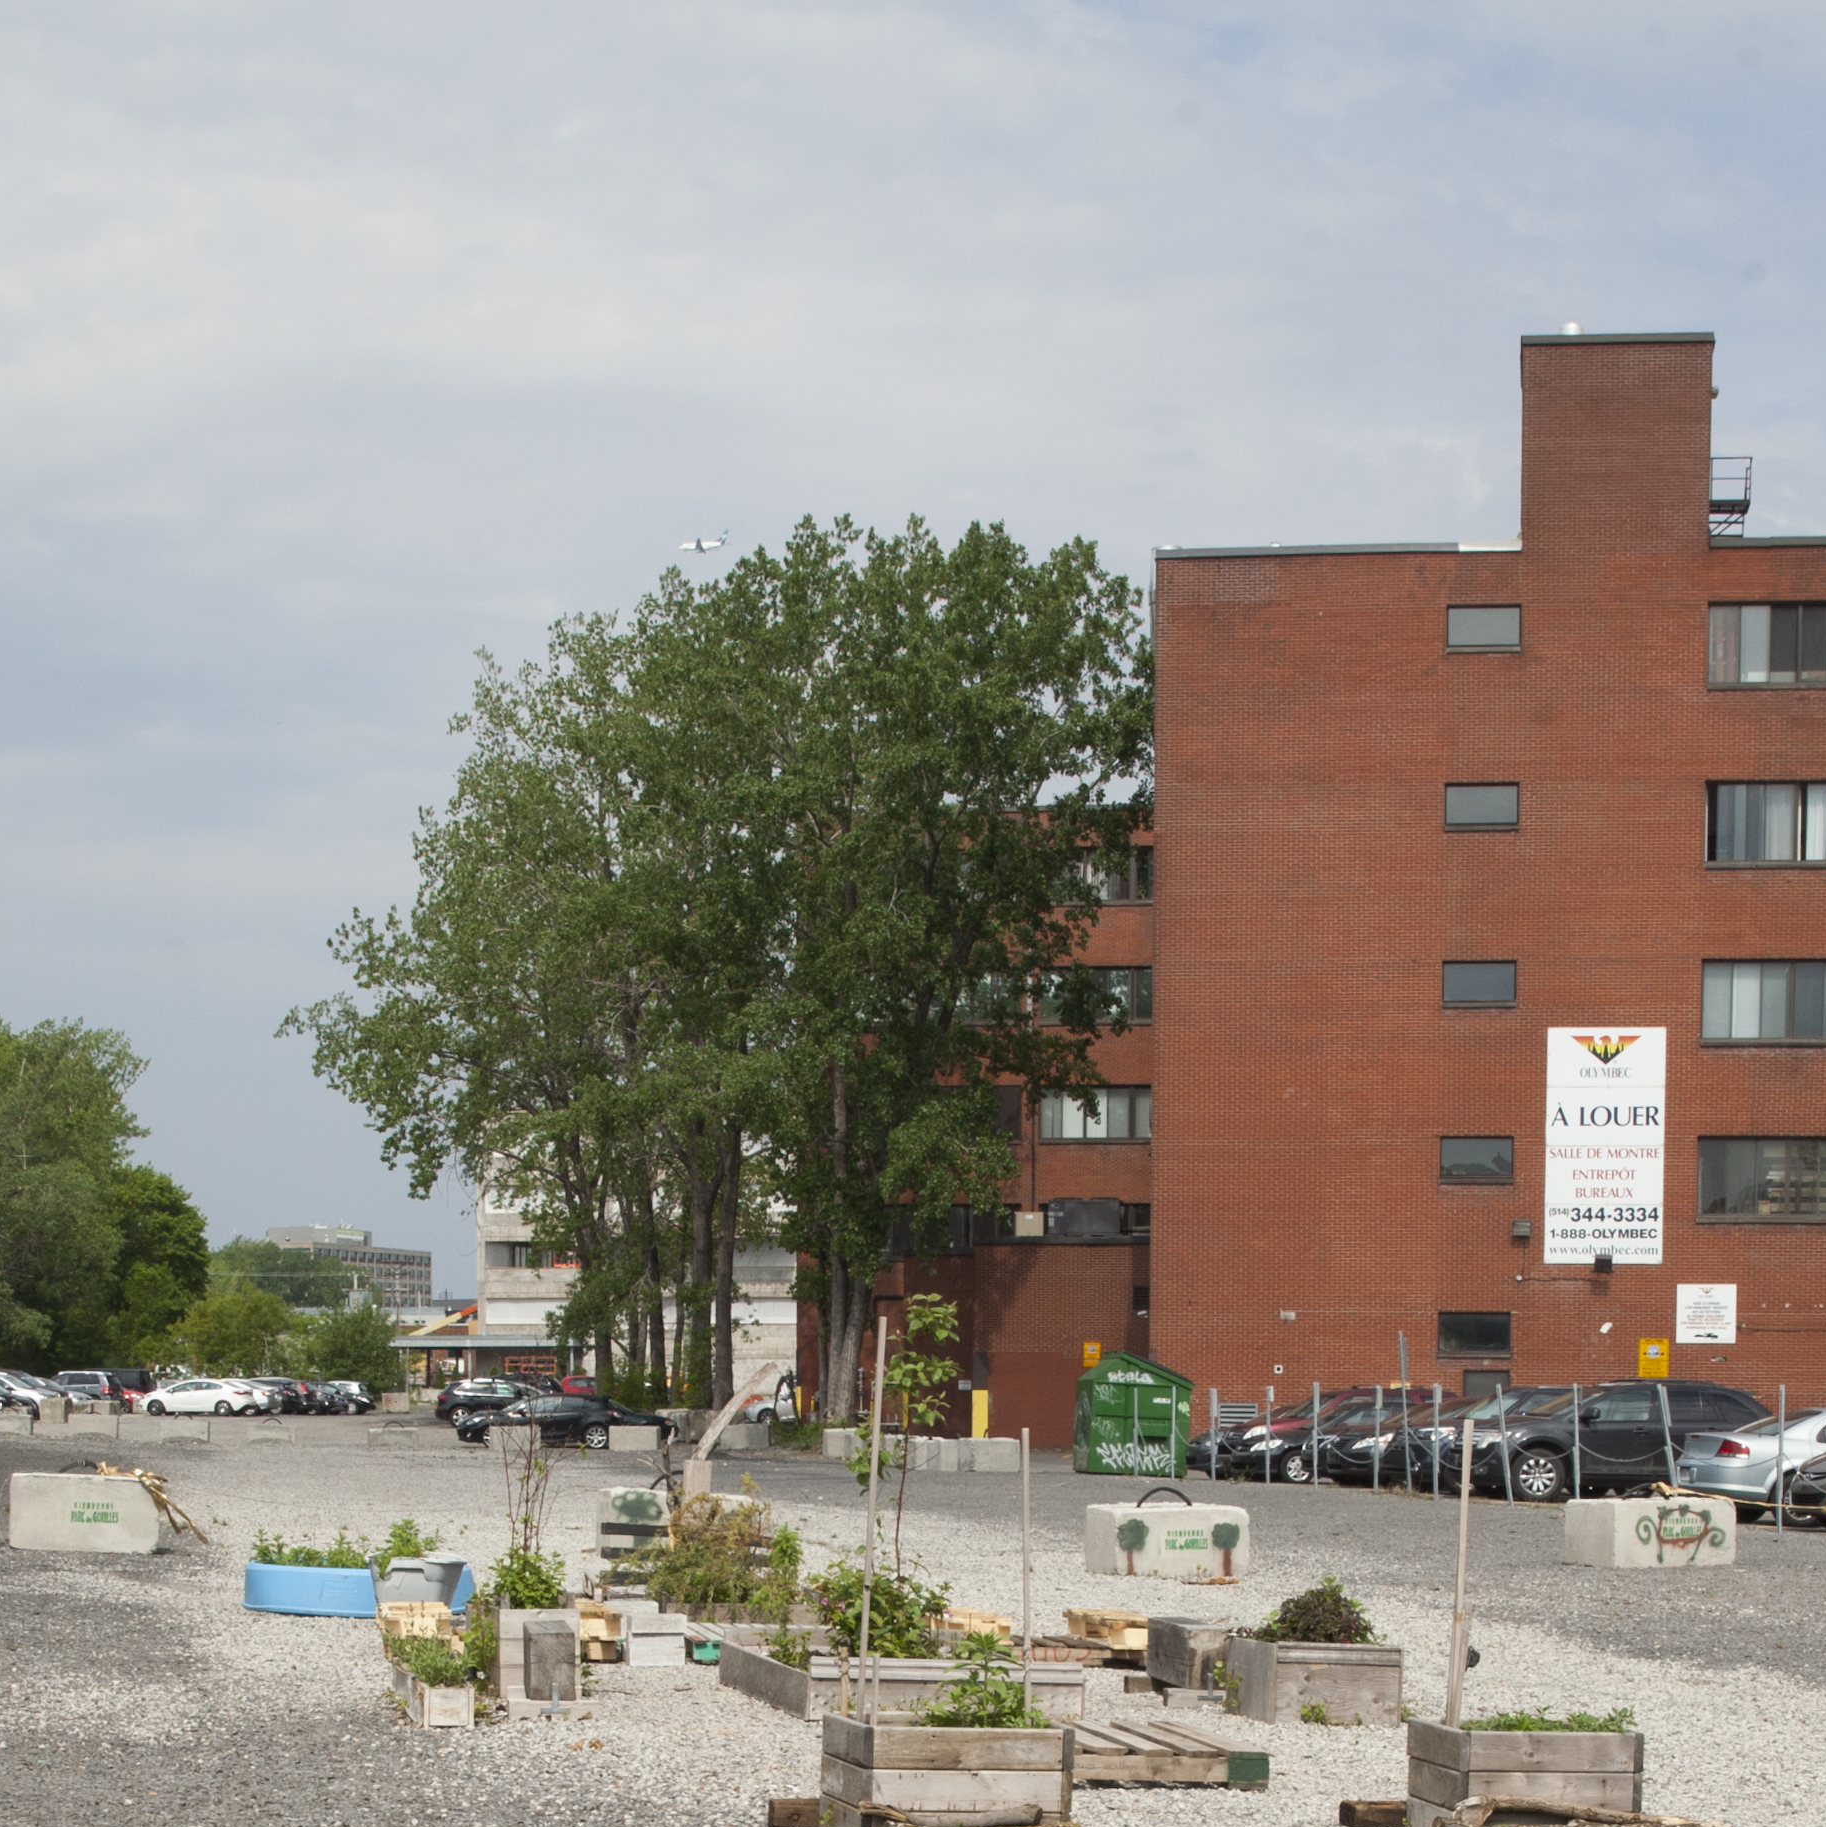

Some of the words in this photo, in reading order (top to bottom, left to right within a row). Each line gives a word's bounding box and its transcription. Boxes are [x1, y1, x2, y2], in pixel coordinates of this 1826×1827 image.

[1580, 1067, 1632, 1078] OLYMBEC
[1551, 1102, 1569, 1127] À
[1579, 1106, 1660, 1127] LOUER
[1549, 1148, 1582, 1159] SALLE
[1586, 1148, 1603, 1159] DE
[1607, 1148, 1660, 1159] MONTRE
[1573, 1167, 1637, 1180] ENTREPÔT
[1575, 1187, 1634, 1198] BUREAUX
[1549, 1208, 1569, 1217] (514)
[1570, 1207, 1659, 1222] 344-3334
[1550, 1228, 1658, 1239] 1-888-OLYMBEC
[1549, 1244, 1659, 1257] www.olymbec.com
